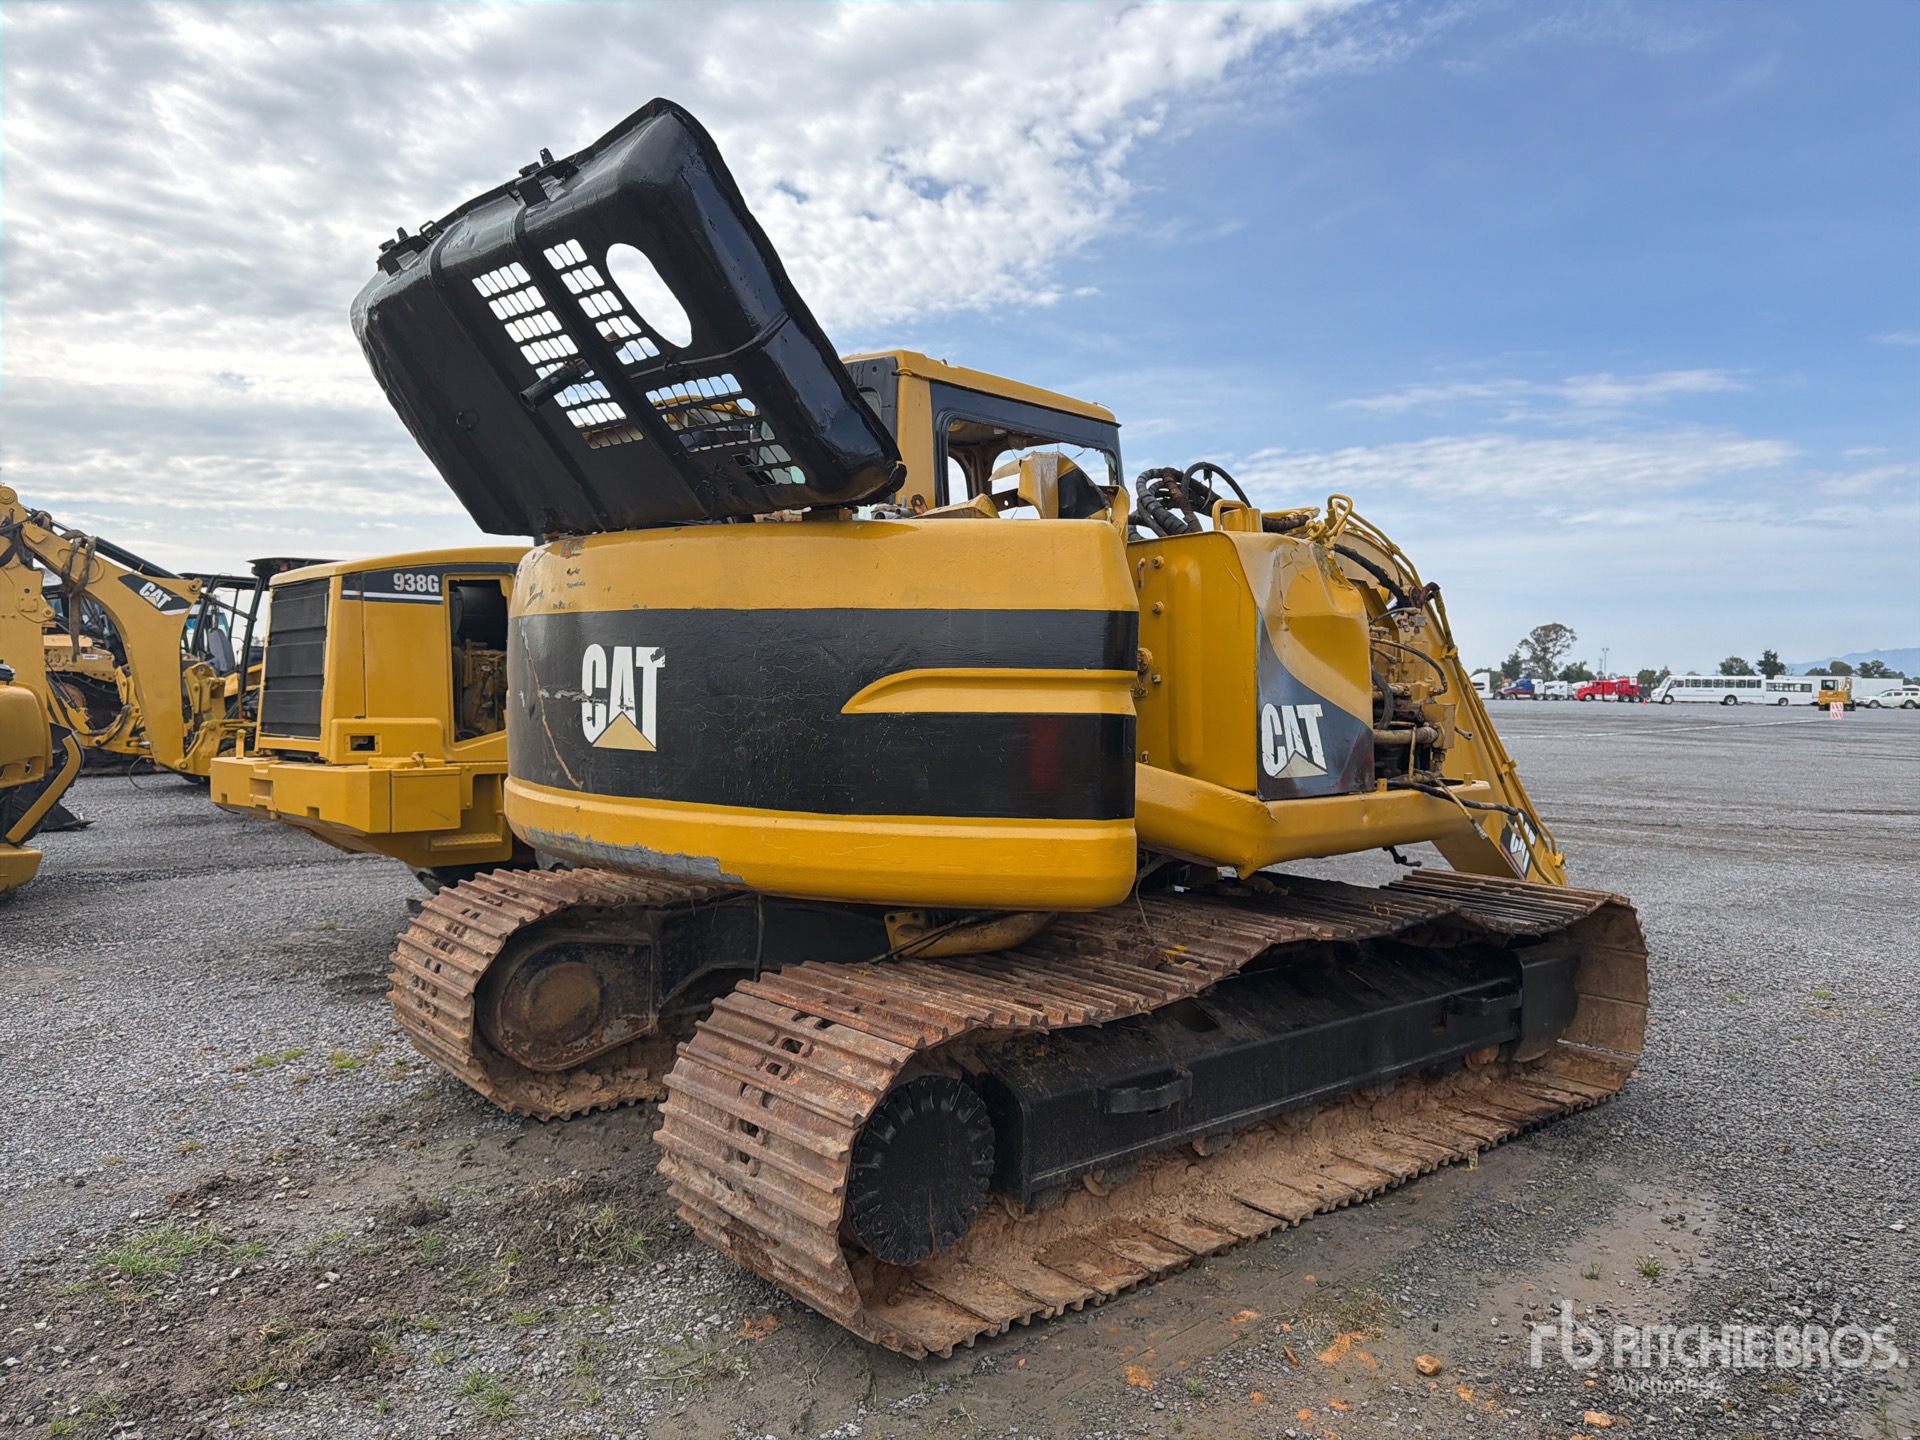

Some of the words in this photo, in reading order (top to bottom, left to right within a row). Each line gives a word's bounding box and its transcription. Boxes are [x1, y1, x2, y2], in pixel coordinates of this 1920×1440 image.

[139, 581, 172, 609] CAT
[393, 572, 440, 593] 938G
[581, 643, 666, 748] CAT
[1261, 703, 1327, 777] CAT
